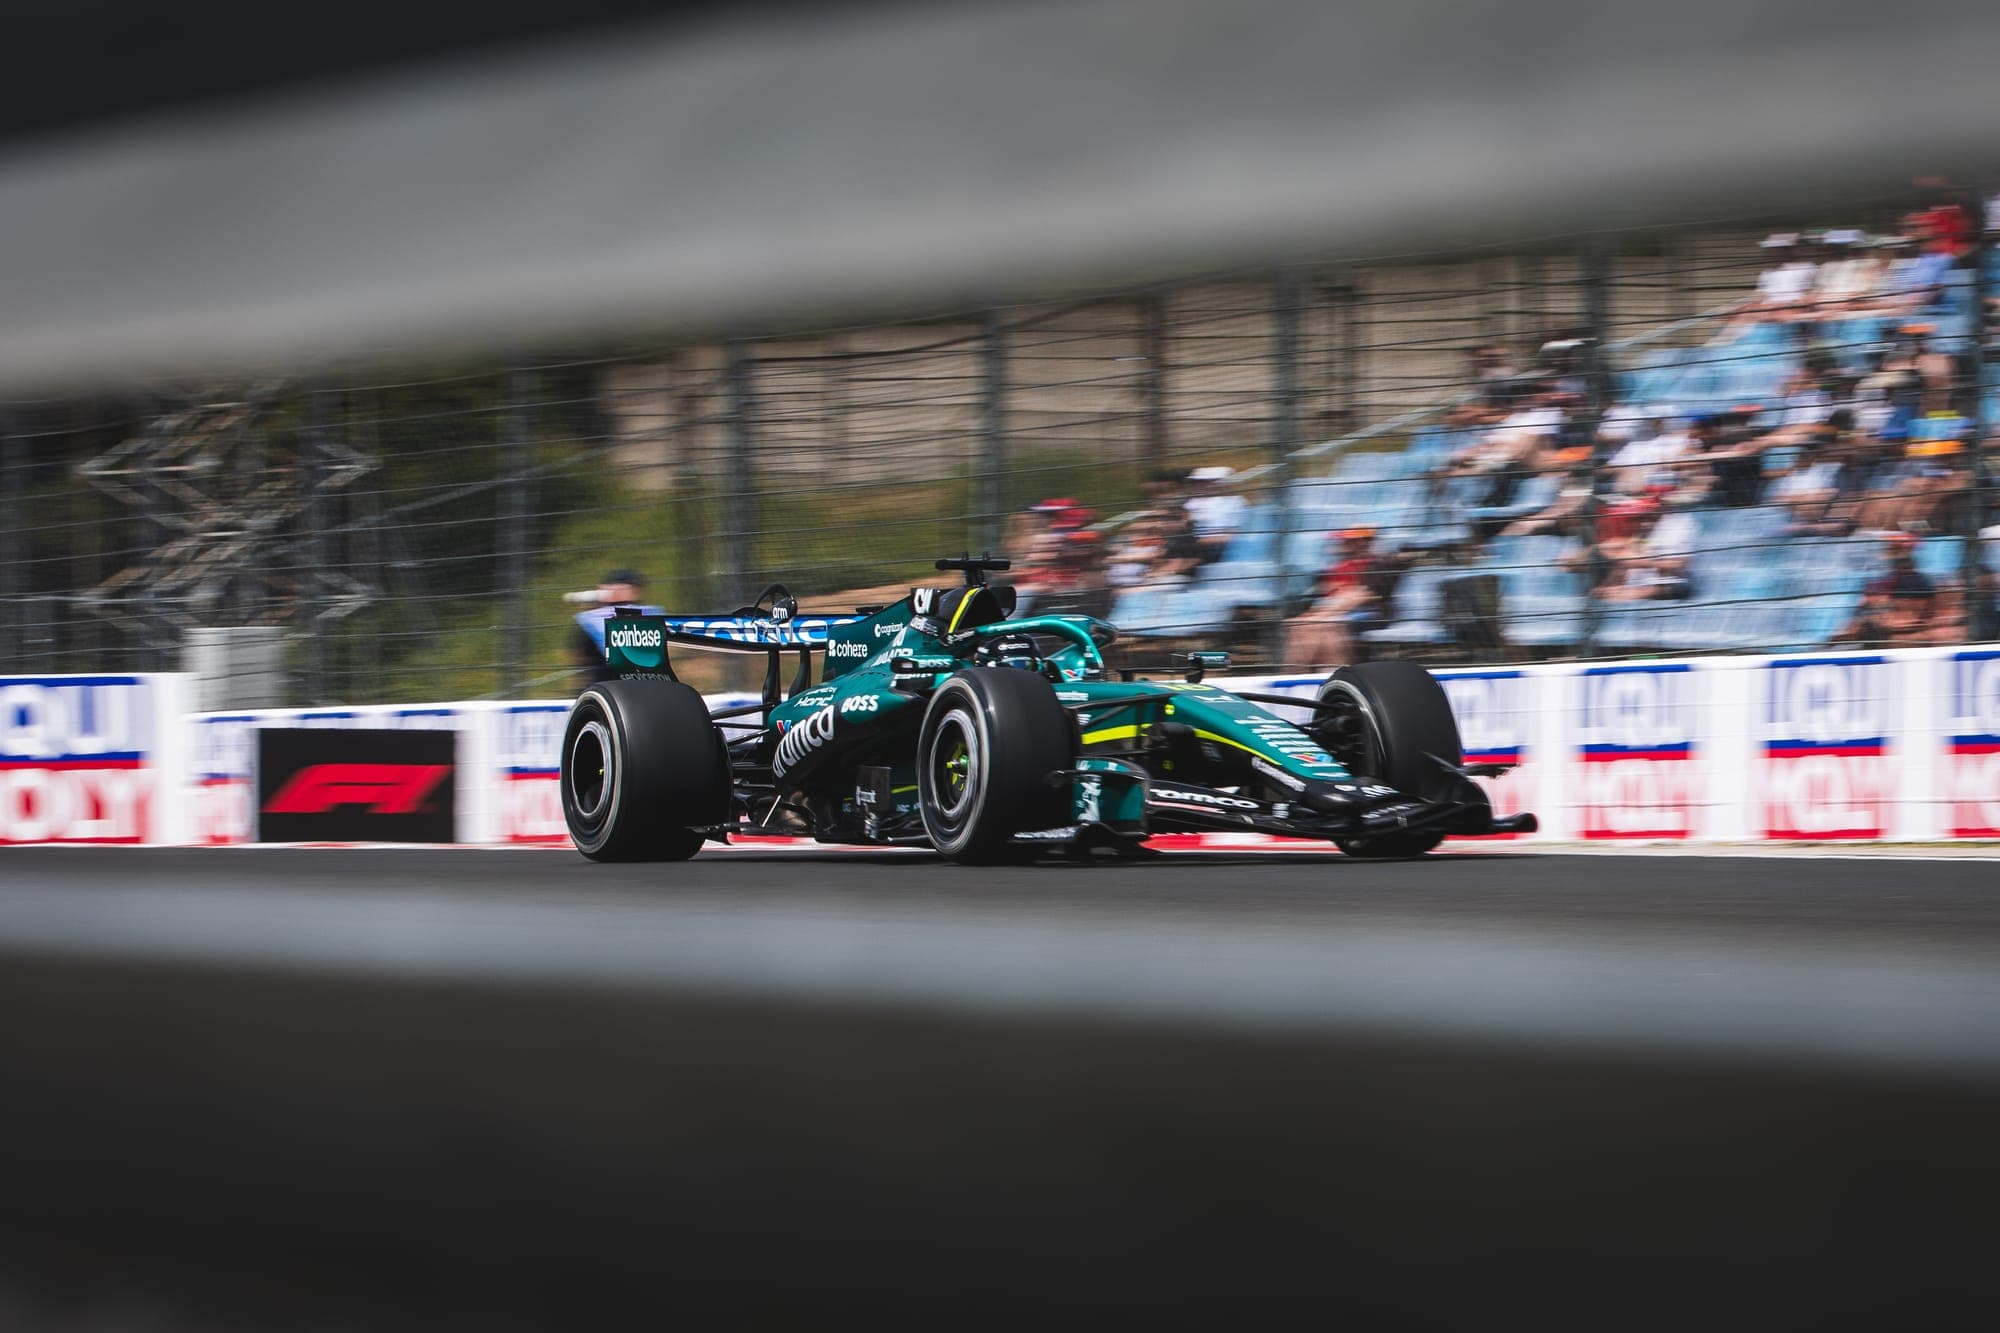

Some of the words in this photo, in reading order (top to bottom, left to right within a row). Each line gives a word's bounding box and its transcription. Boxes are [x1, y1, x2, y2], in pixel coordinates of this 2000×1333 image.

[773, 606, 788, 620] arm
[611, 624, 661, 648] coinbase
[836, 642, 868, 658] cohere
[841, 694, 880, 713] BOSS
